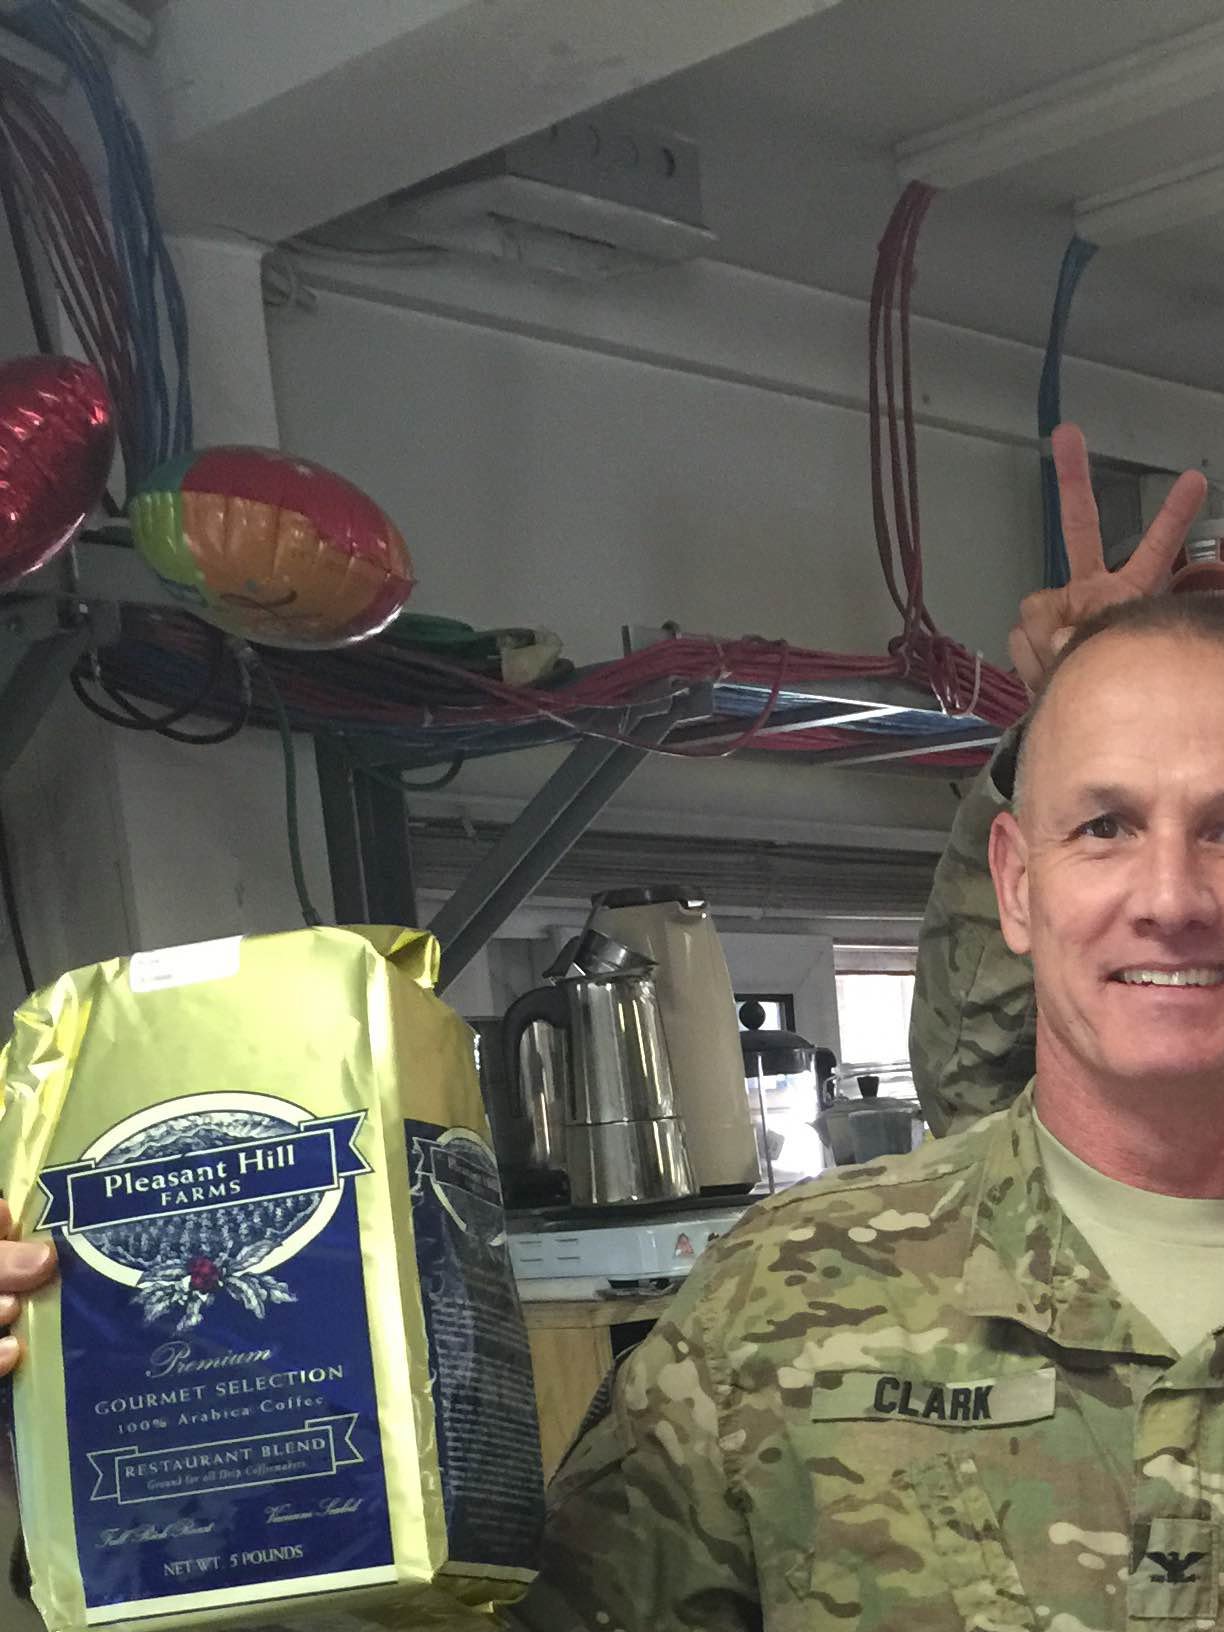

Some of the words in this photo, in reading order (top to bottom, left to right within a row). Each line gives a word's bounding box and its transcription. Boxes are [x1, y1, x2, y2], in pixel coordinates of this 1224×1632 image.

[104, 1161, 227, 1198] Pleasant
[238, 1144, 296, 1174] Hill
[161, 1180, 241, 1206] FARMS
[145, 1340, 272, 1378] Premium
[94, 1385, 206, 1415] GOURMET
[215, 1365, 344, 1396] SELECTION
[873, 1376, 995, 1421] CLARK
[118, 1418, 167, 1435] 100%
[178, 1405, 250, 1426] Arabica
[260, 1394, 325, 1413] Coffee
[125, 1450, 250, 1478] RESTAURANT
[261, 1438, 326, 1458] BLEND
[164, 1561, 194, 1577] NET
[230, 1554, 239, 1567] 5
[242, 1545, 304, 1563] POUNDS
